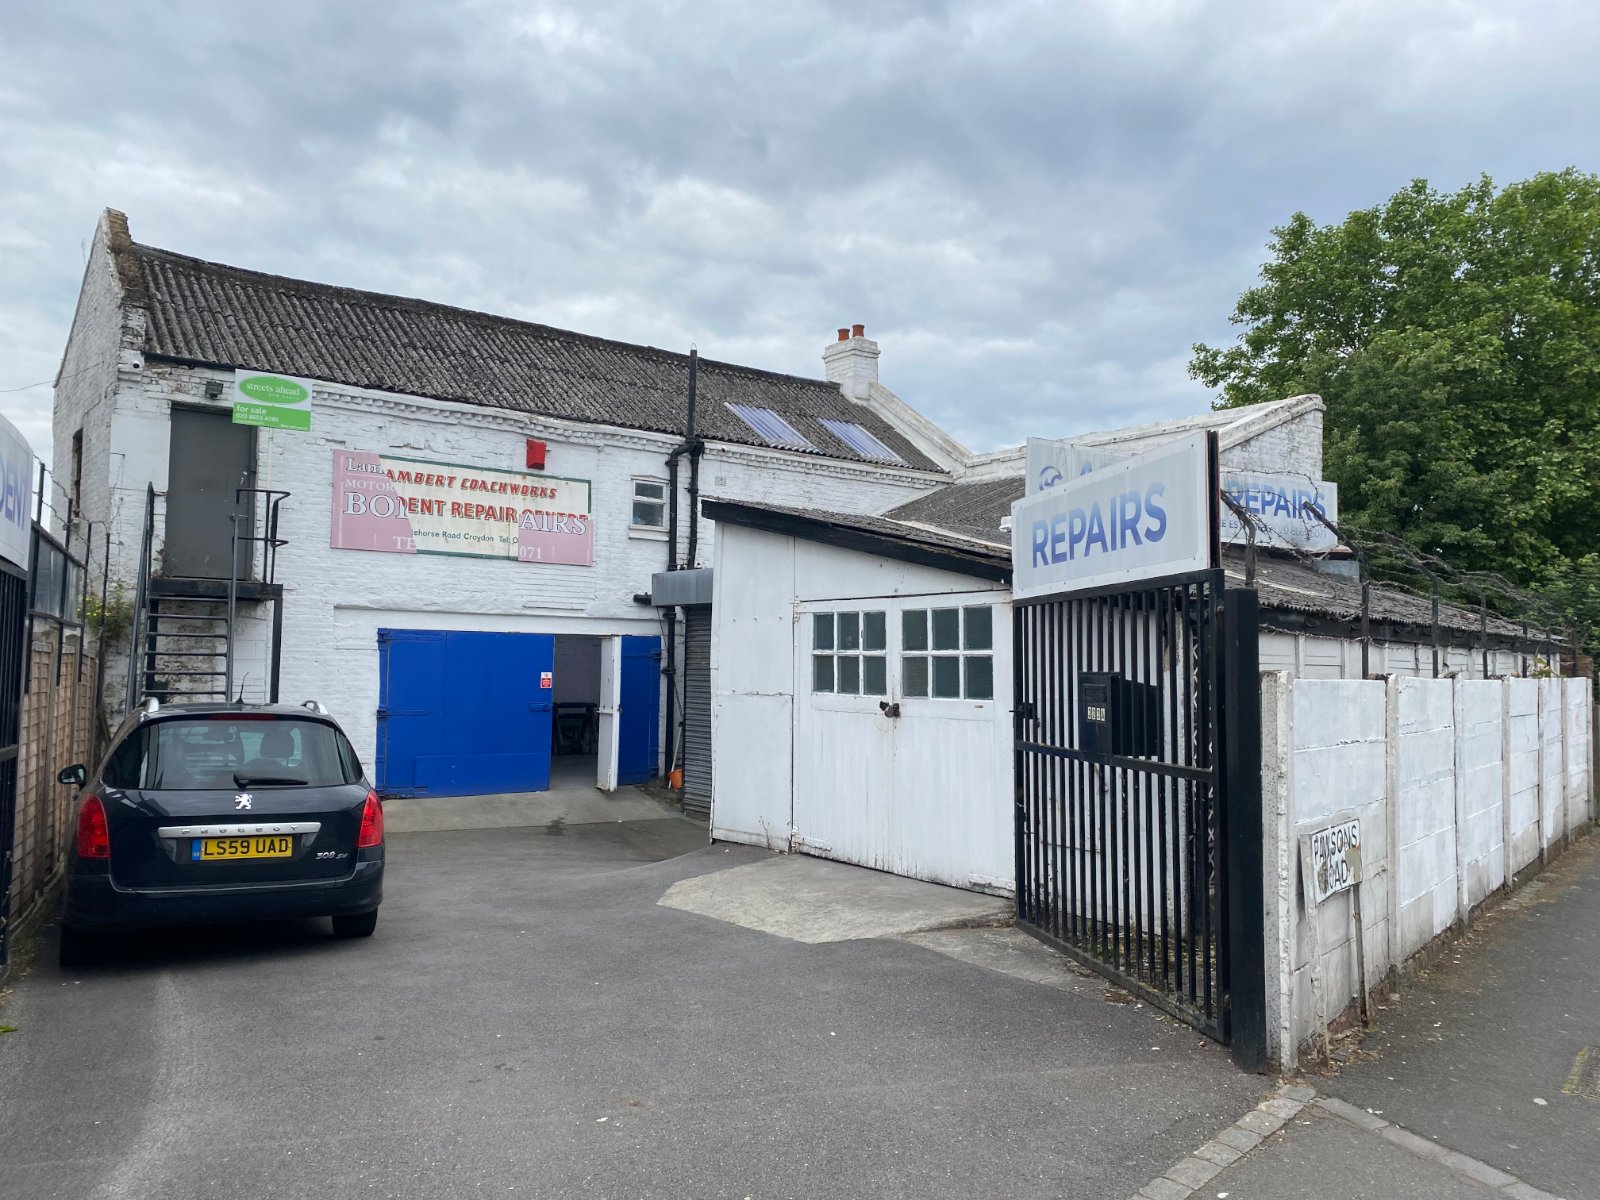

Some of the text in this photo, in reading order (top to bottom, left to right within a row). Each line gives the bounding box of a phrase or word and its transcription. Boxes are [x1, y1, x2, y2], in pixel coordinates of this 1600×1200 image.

[246, 383, 300, 396] streets ahead
[236, 405, 267, 415] for sale
[460, 478, 557, 500] COACHWORKS
[1229, 479, 1327, 525] REPAIRS
[451, 502, 518, 524] REPAIR
[1032, 482, 1167, 569] REPAIRS
[442, 531, 462, 540] Road
[464, 532, 495, 543] Croydon
[181, 825, 299, 835] PEUGEOT
[204, 838, 289, 856] LS59 UAD
[315, 851, 336, 860] 308
